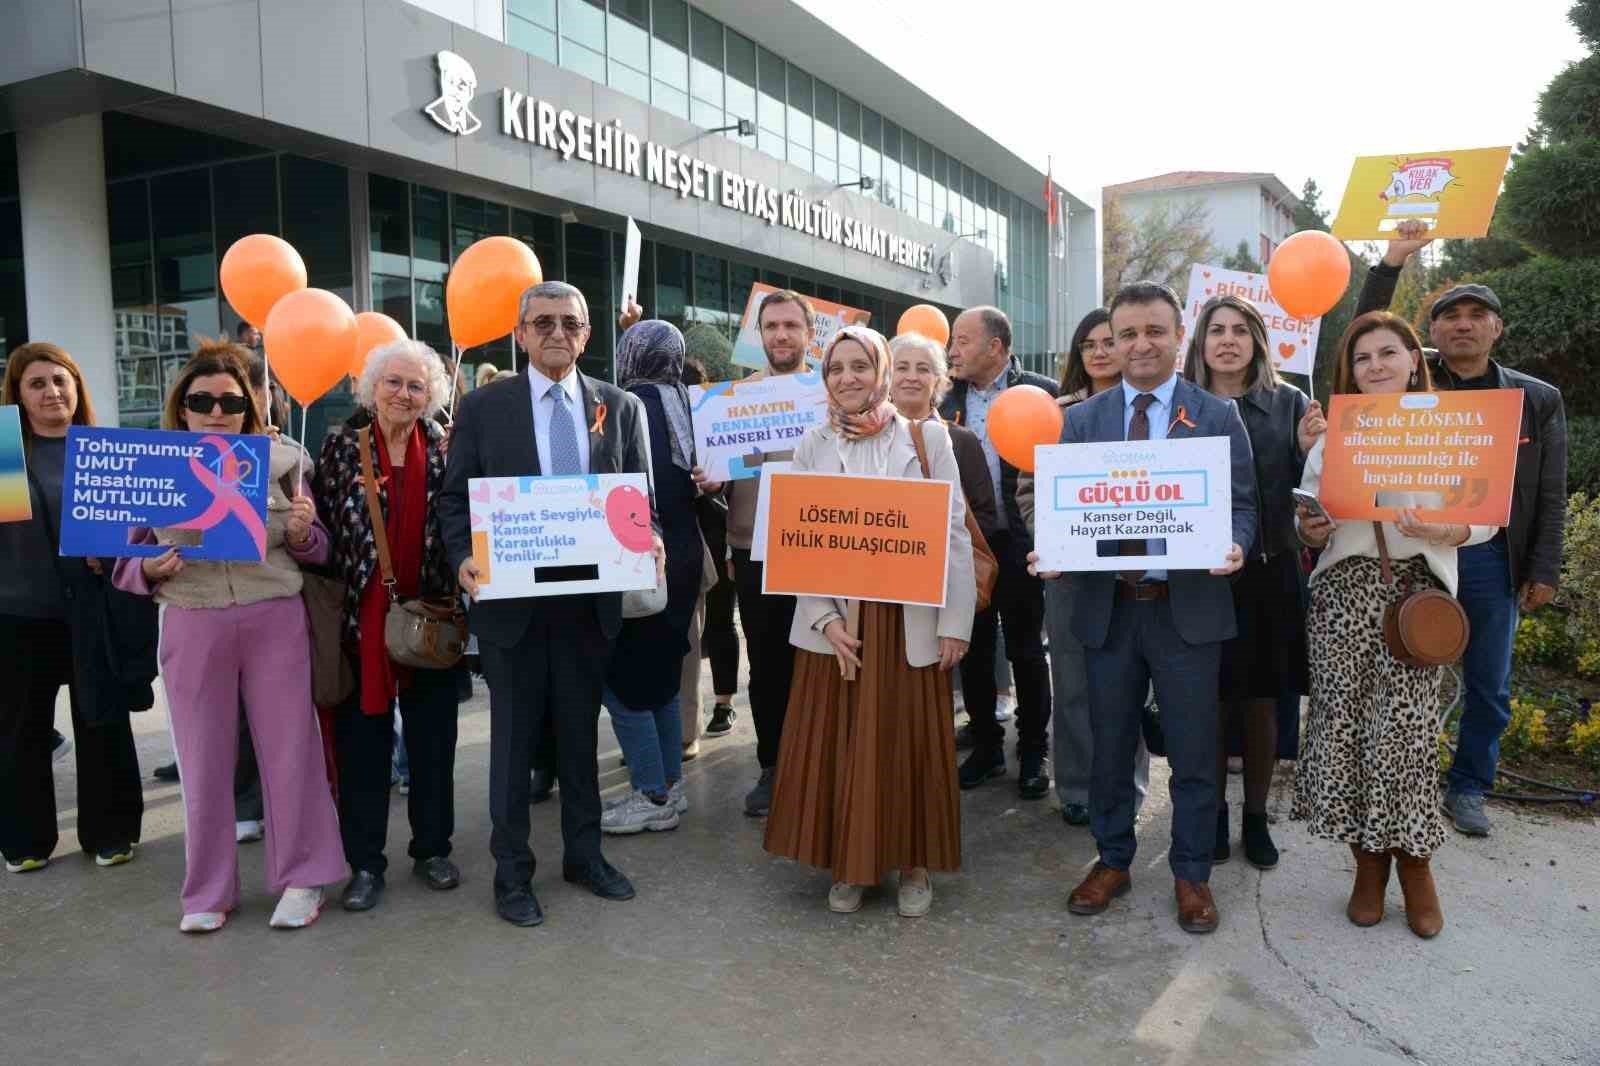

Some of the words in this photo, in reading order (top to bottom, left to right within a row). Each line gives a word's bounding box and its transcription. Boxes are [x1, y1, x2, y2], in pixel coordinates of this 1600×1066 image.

[503, 87, 641, 177] KIRŞEHİR
[646, 141, 717, 200] NEŞET
[721, 170, 778, 226] ERTAŞ
[782, 188, 842, 244] KÜLTÜR
[844, 216, 887, 259] SANAT
[727, 400, 796, 418] HAYATIN
[711, 411, 815, 434] RENKLERİYLE
[1356, 412, 1383, 429] Sen
[1387, 411, 1405, 428] de
[1410, 408, 1486, 427] LÖSEMA
[705, 427, 773, 448] KANSERİ
[1343, 432, 1401, 447] ailesine
[1405, 431, 1440, 447] katıl
[1444, 432, 1494, 447] akran
[75, 437, 204, 458] Tohumumuz
[75, 455, 137, 471] UMUT
[1353, 450, 1452, 467] danışmanlığı
[1458, 451, 1479, 466] ile
[74, 472, 175, 490] Hasatımız
[1363, 469, 1413, 487] hayata
[1417, 473, 1462, 487] tutun
[73, 489, 187, 507] MUTLULUK
[1078, 480, 1151, 507] GÜÇLÜ
[1155, 483, 1184, 501] OL
[72, 505, 147, 523] Olsun...
[491, 511, 537, 525] Hayat
[540, 507, 606, 523] Sevgiyle,
[799, 504, 860, 525] LÖSEMİ
[863, 508, 909, 529] DEĞİL
[1083, 510, 1132, 523] Kanser
[1136, 508, 1177, 524] Değil,
[493, 524, 545, 537] Kanser
[1070, 524, 1112, 538] Hayat
[1115, 521, 1194, 535] Kazanacak
[494, 535, 577, 550] Kararlılıkla
[781, 529, 824, 548] İYİLİK
[828, 533, 927, 556] BULAŞICIDIR
